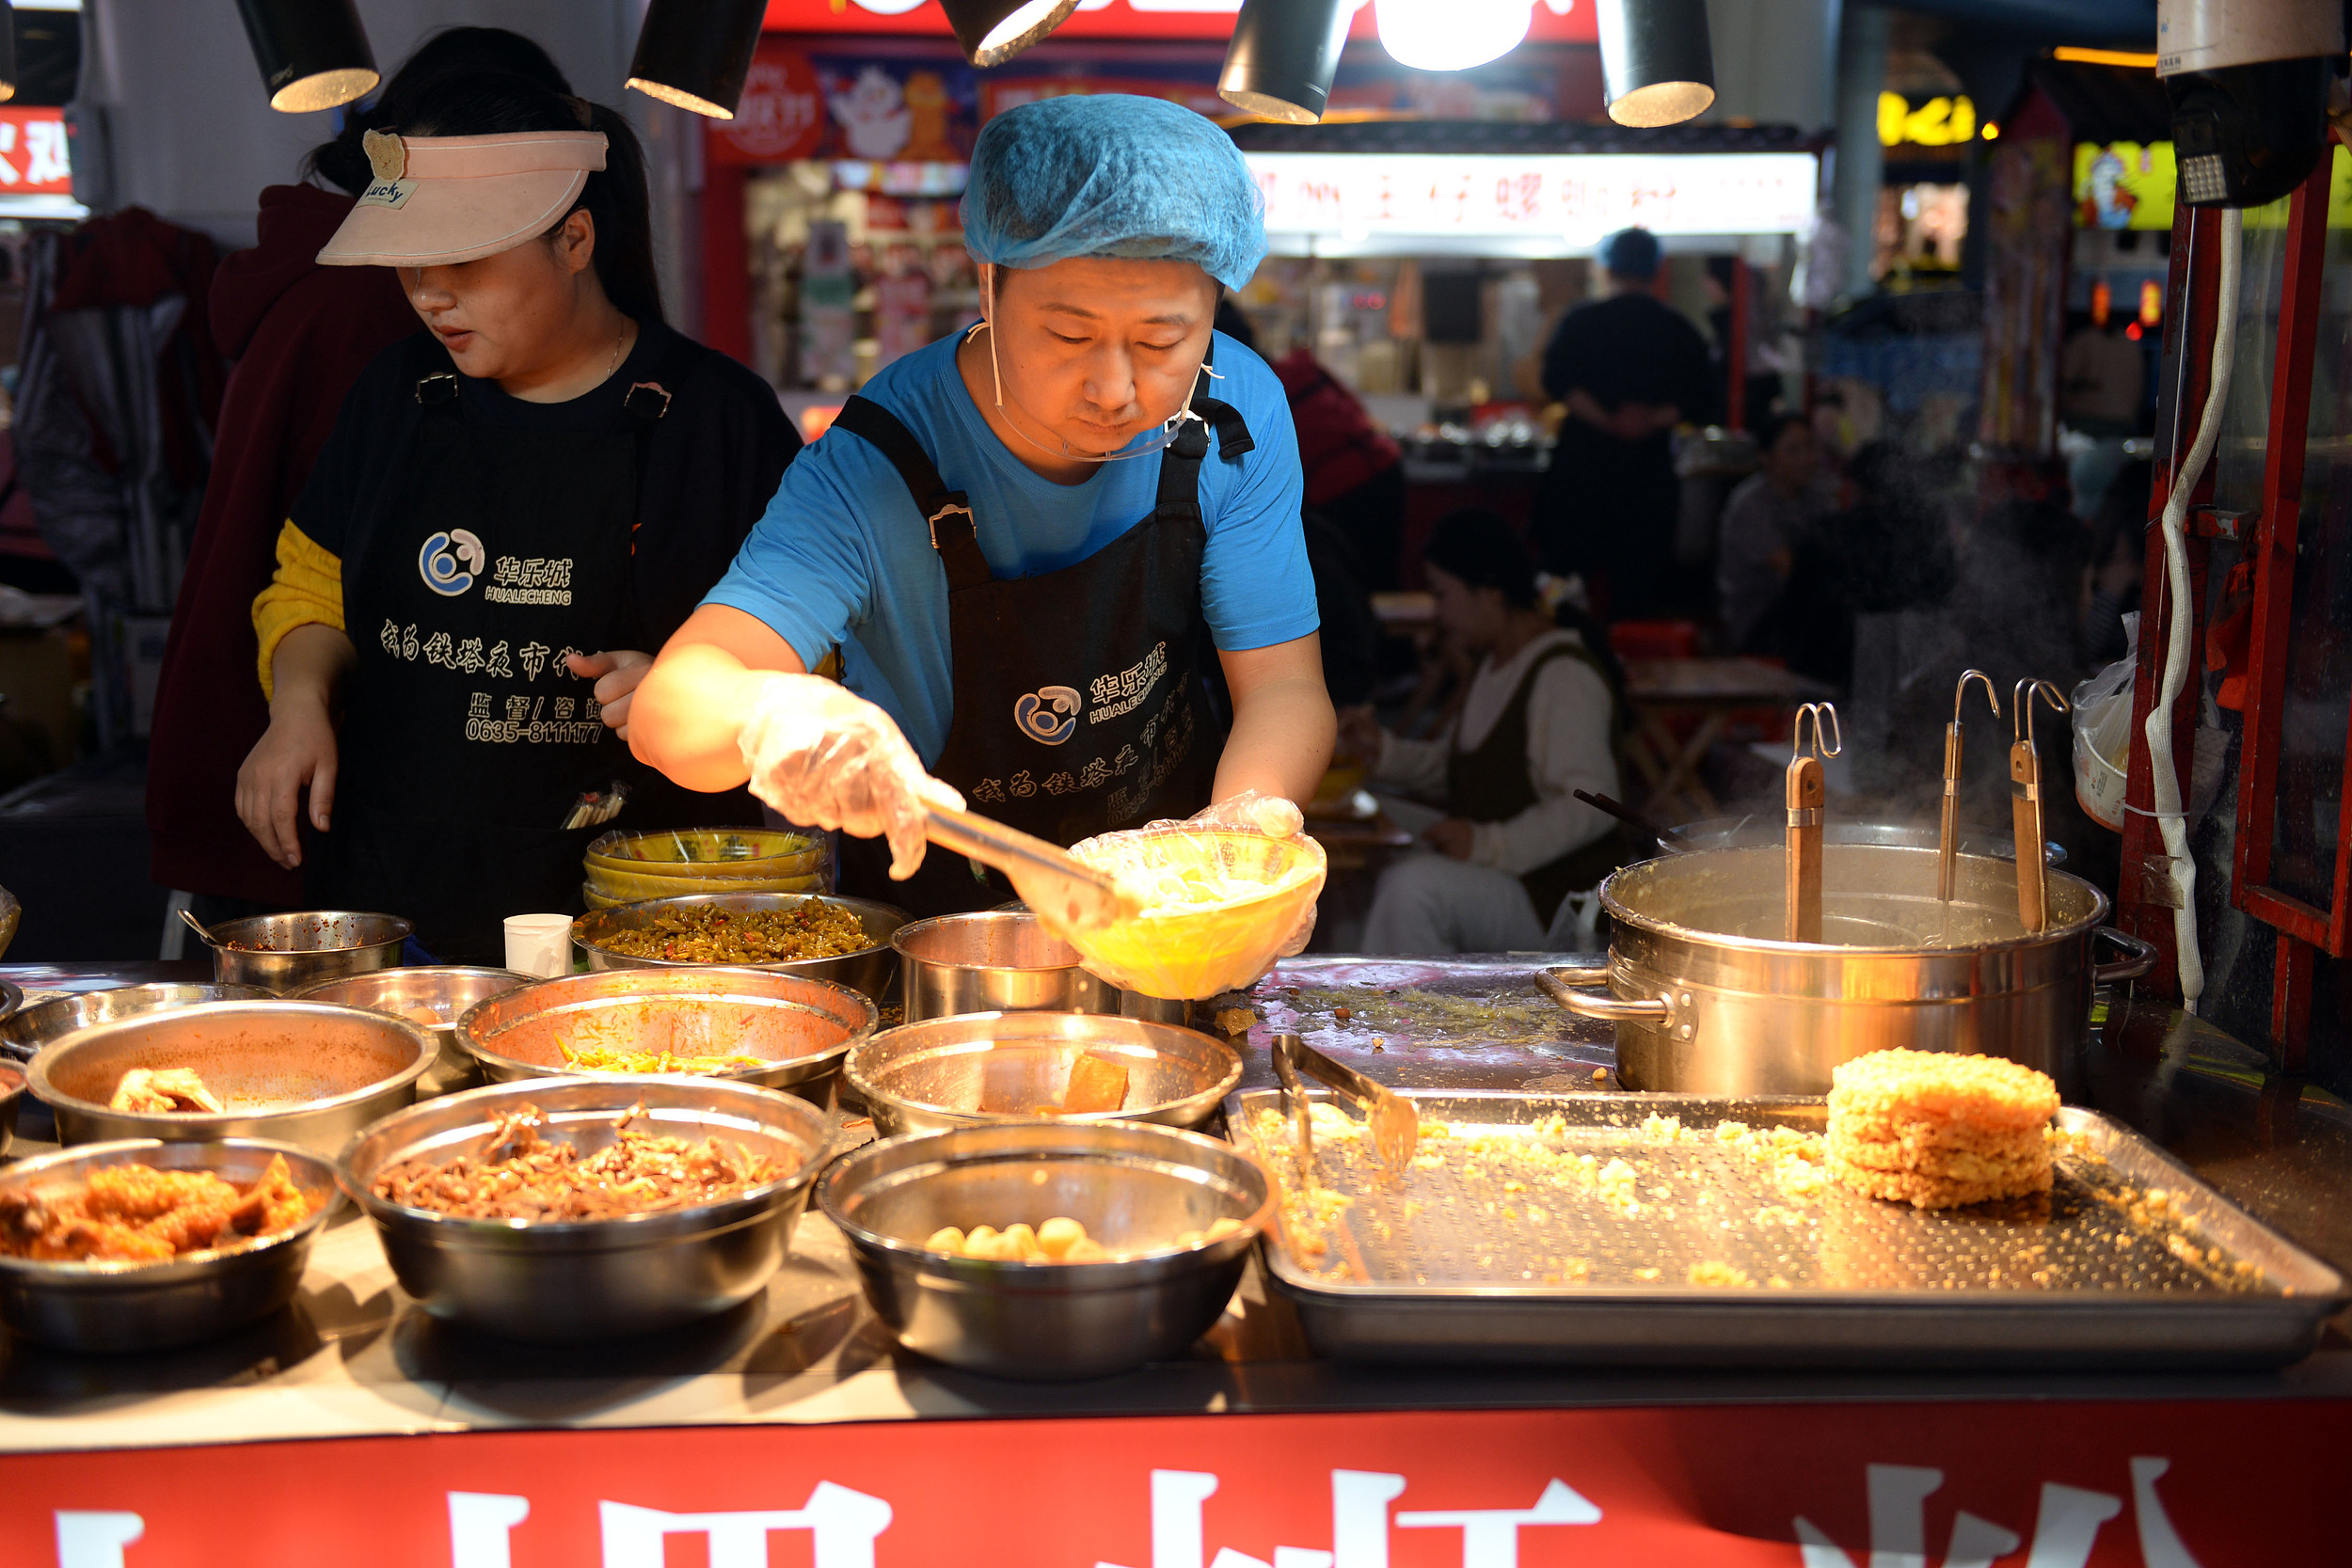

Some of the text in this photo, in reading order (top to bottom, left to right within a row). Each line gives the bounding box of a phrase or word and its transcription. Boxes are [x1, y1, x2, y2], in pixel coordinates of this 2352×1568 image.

[493, 555, 574, 589] 华乐城
[484, 584, 572, 607] HUALECHENG
[1089, 641, 1167, 705] 华乐城
[1089, 661, 1168, 725] HUALECHENG
[466, 718, 604, 744] 0635-8111177
